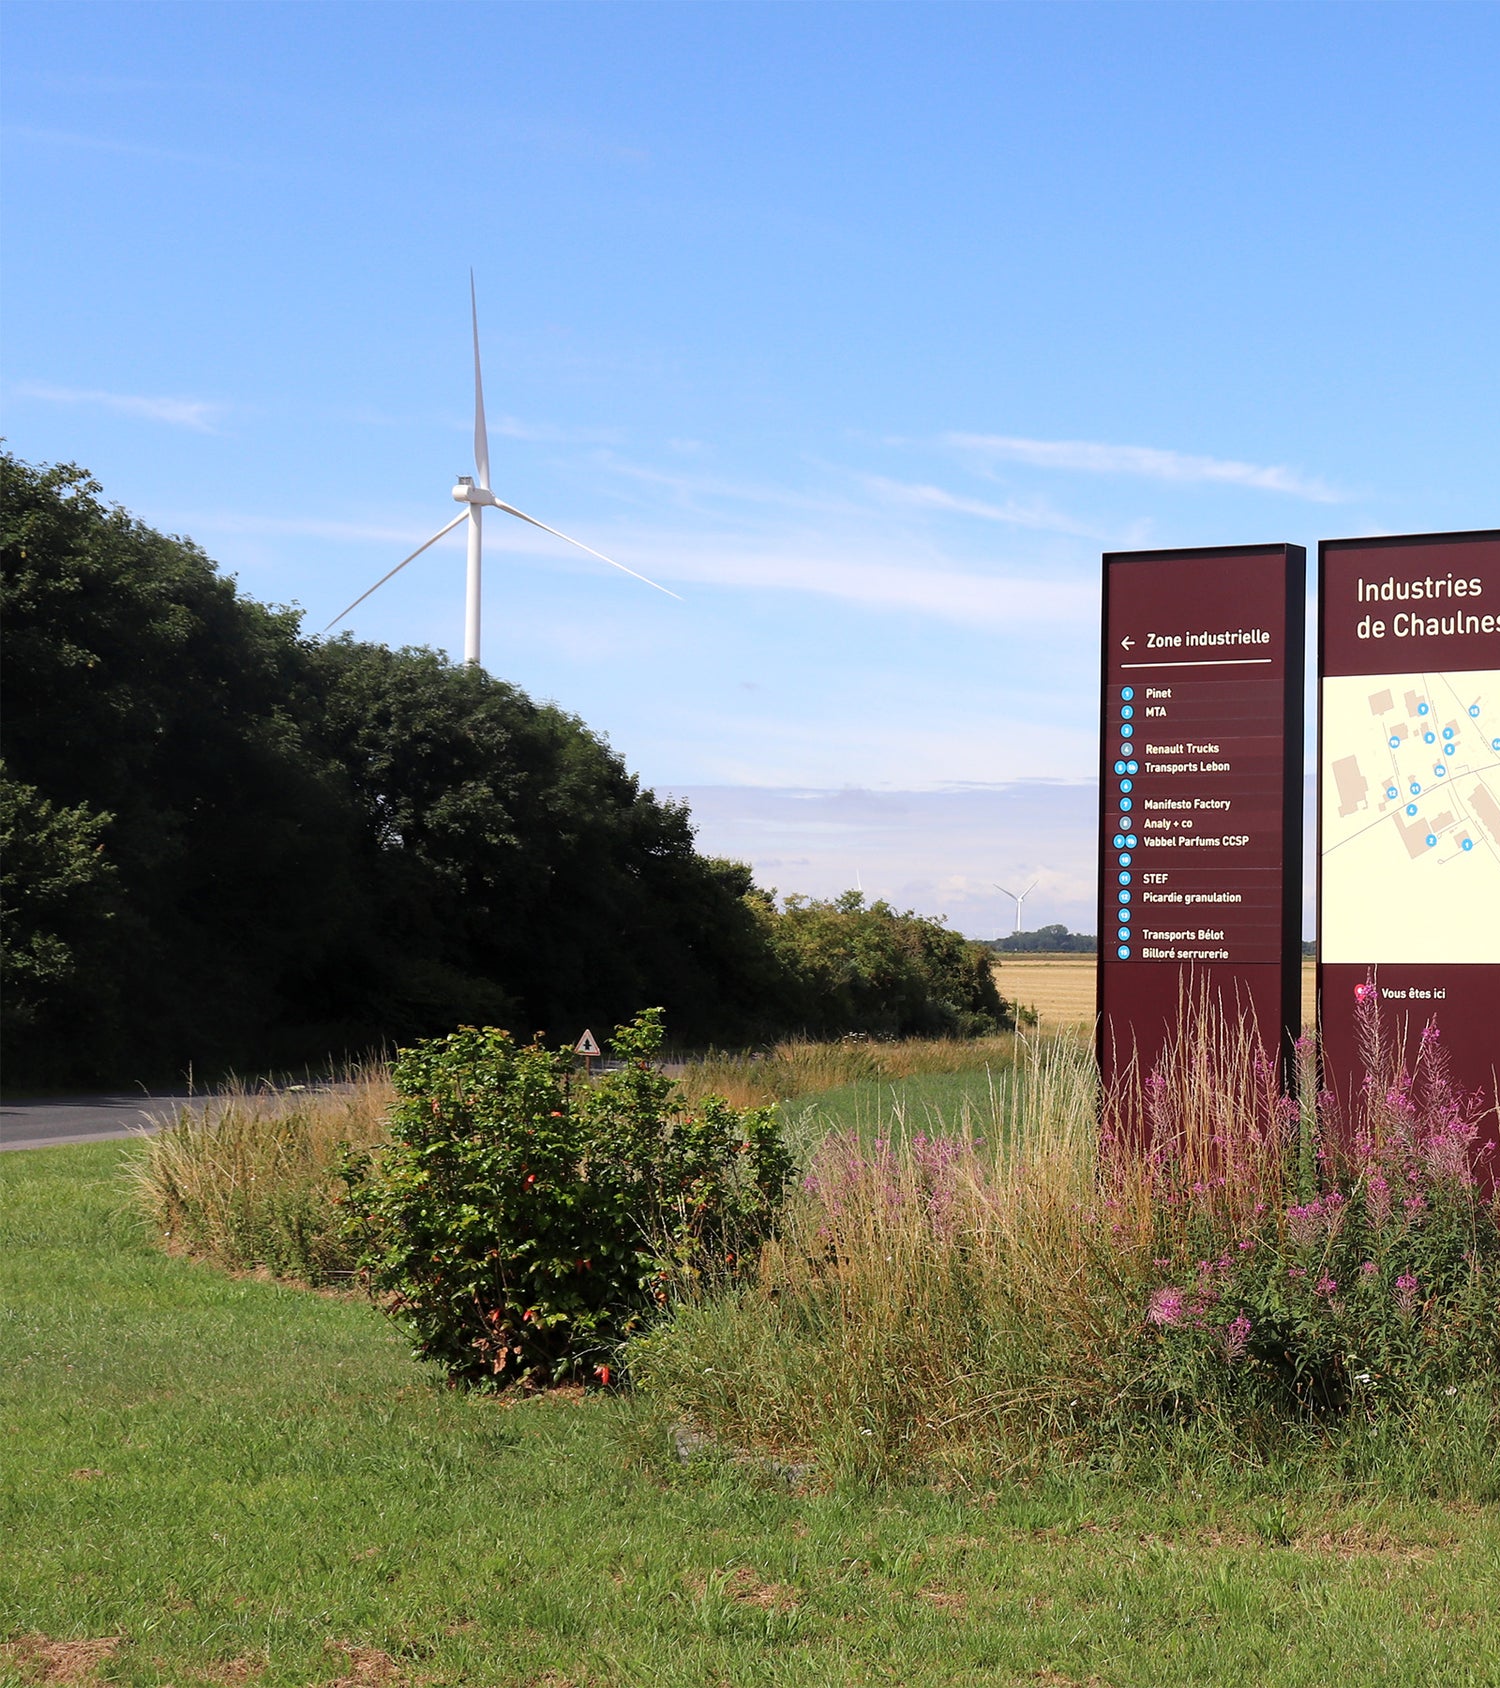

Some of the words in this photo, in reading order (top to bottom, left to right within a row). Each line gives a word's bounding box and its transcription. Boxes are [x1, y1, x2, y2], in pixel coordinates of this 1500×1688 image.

[1359, 573, 1481, 601] Industries
[1358, 615, 1385, 638] de
[1147, 634, 1181, 647] Zone
[1186, 629, 1269, 646] industrielle
[1147, 688, 1171, 698] Pinet
[1146, 707, 1166, 717] MTA
[1146, 744, 1183, 754] Renault
[1187, 743, 1219, 753] Trucks
[1145, 763, 1197, 774] Transports
[1201, 761, 1229, 771] Lebon
[1145, 799, 1191, 809] Manifesto
[1194, 799, 1230, 810] Factory
[1144, 819, 1171, 830] Analy
[1182, 820, 1192, 828] co
[1144, 837, 1176, 846] Vabbel
[1179, 836, 1220, 846] Parfums
[1223, 836, 1249, 846] CCSP
[1144, 874, 1168, 883] STEF
[1144, 892, 1182, 902] Picardie
[1185, 892, 1241, 904] granulation
[1143, 930, 1195, 941] Transports
[1198, 929, 1224, 939] Bélot
[1143, 948, 1175, 958] Billoré
[1177, 949, 1228, 958] serrurerie
[1382, 988, 1406, 998] Vous
[1409, 988, 1431, 998] êtes
[1434, 988, 1445, 998] ici
